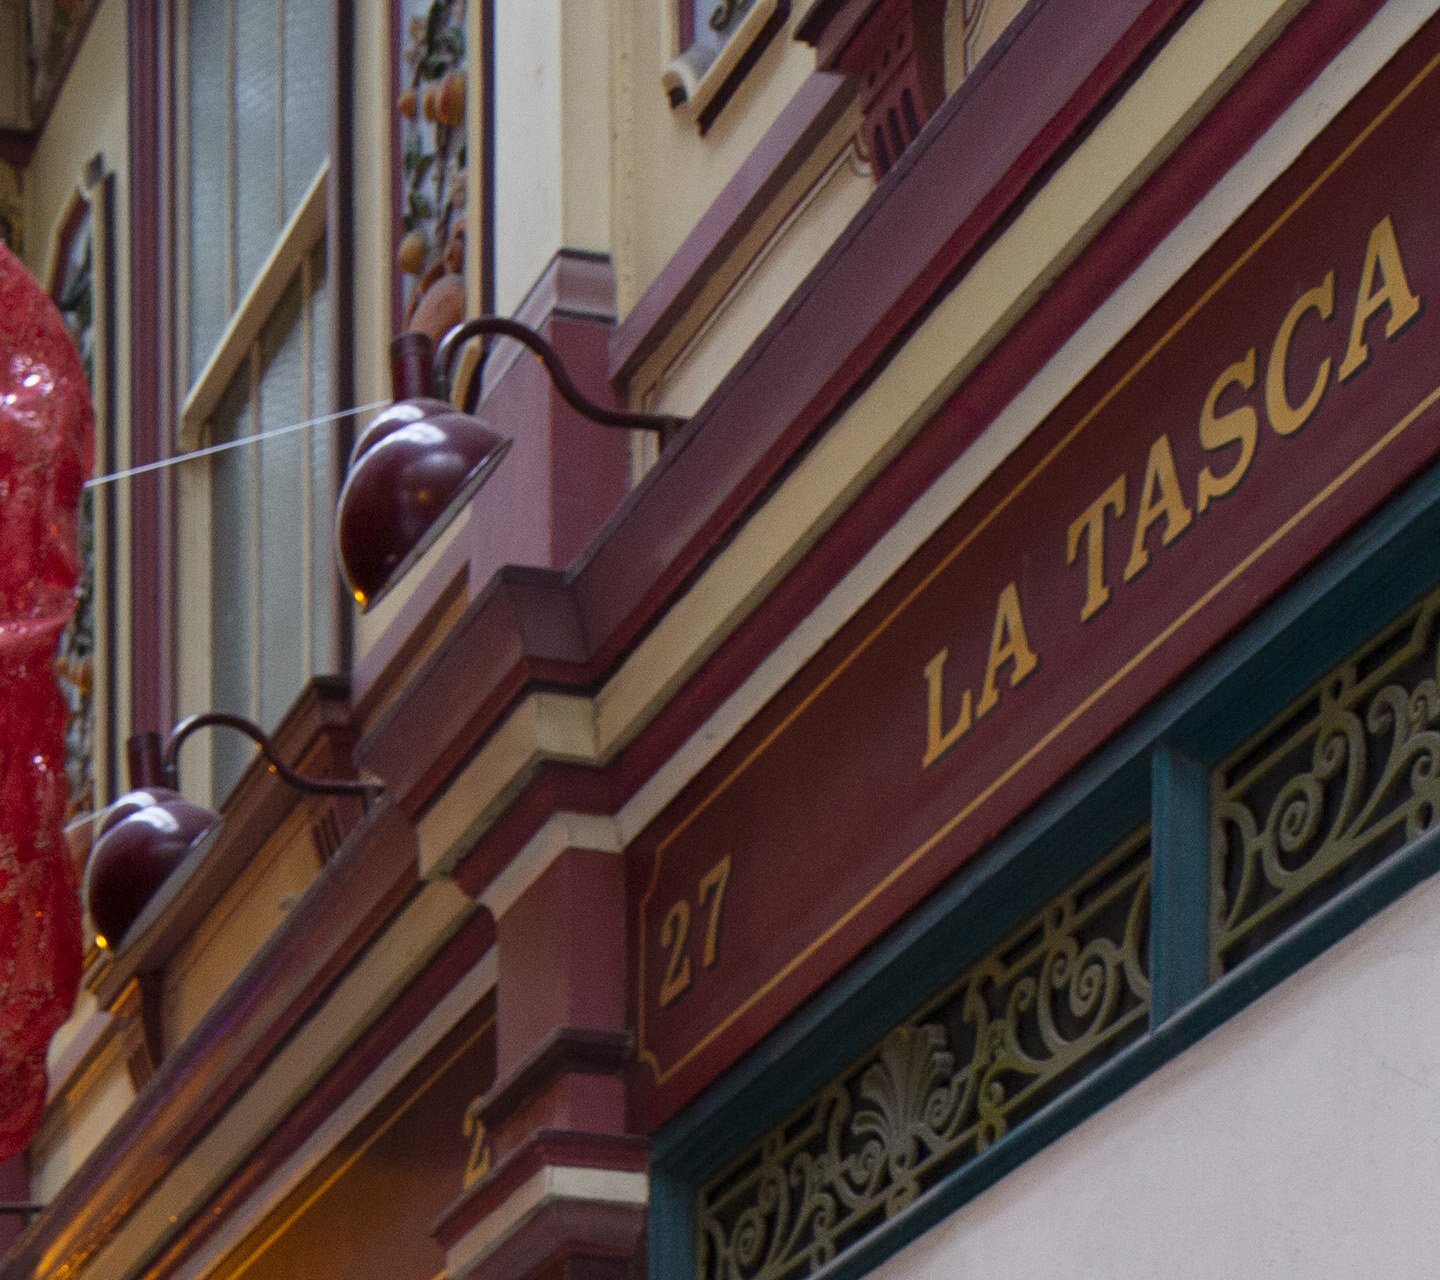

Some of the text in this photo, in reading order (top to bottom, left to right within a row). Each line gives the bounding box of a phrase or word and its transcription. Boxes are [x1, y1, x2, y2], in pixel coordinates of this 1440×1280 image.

[922, 215, 1421, 771] LA TASCA
[659, 854, 732, 1007] 27
